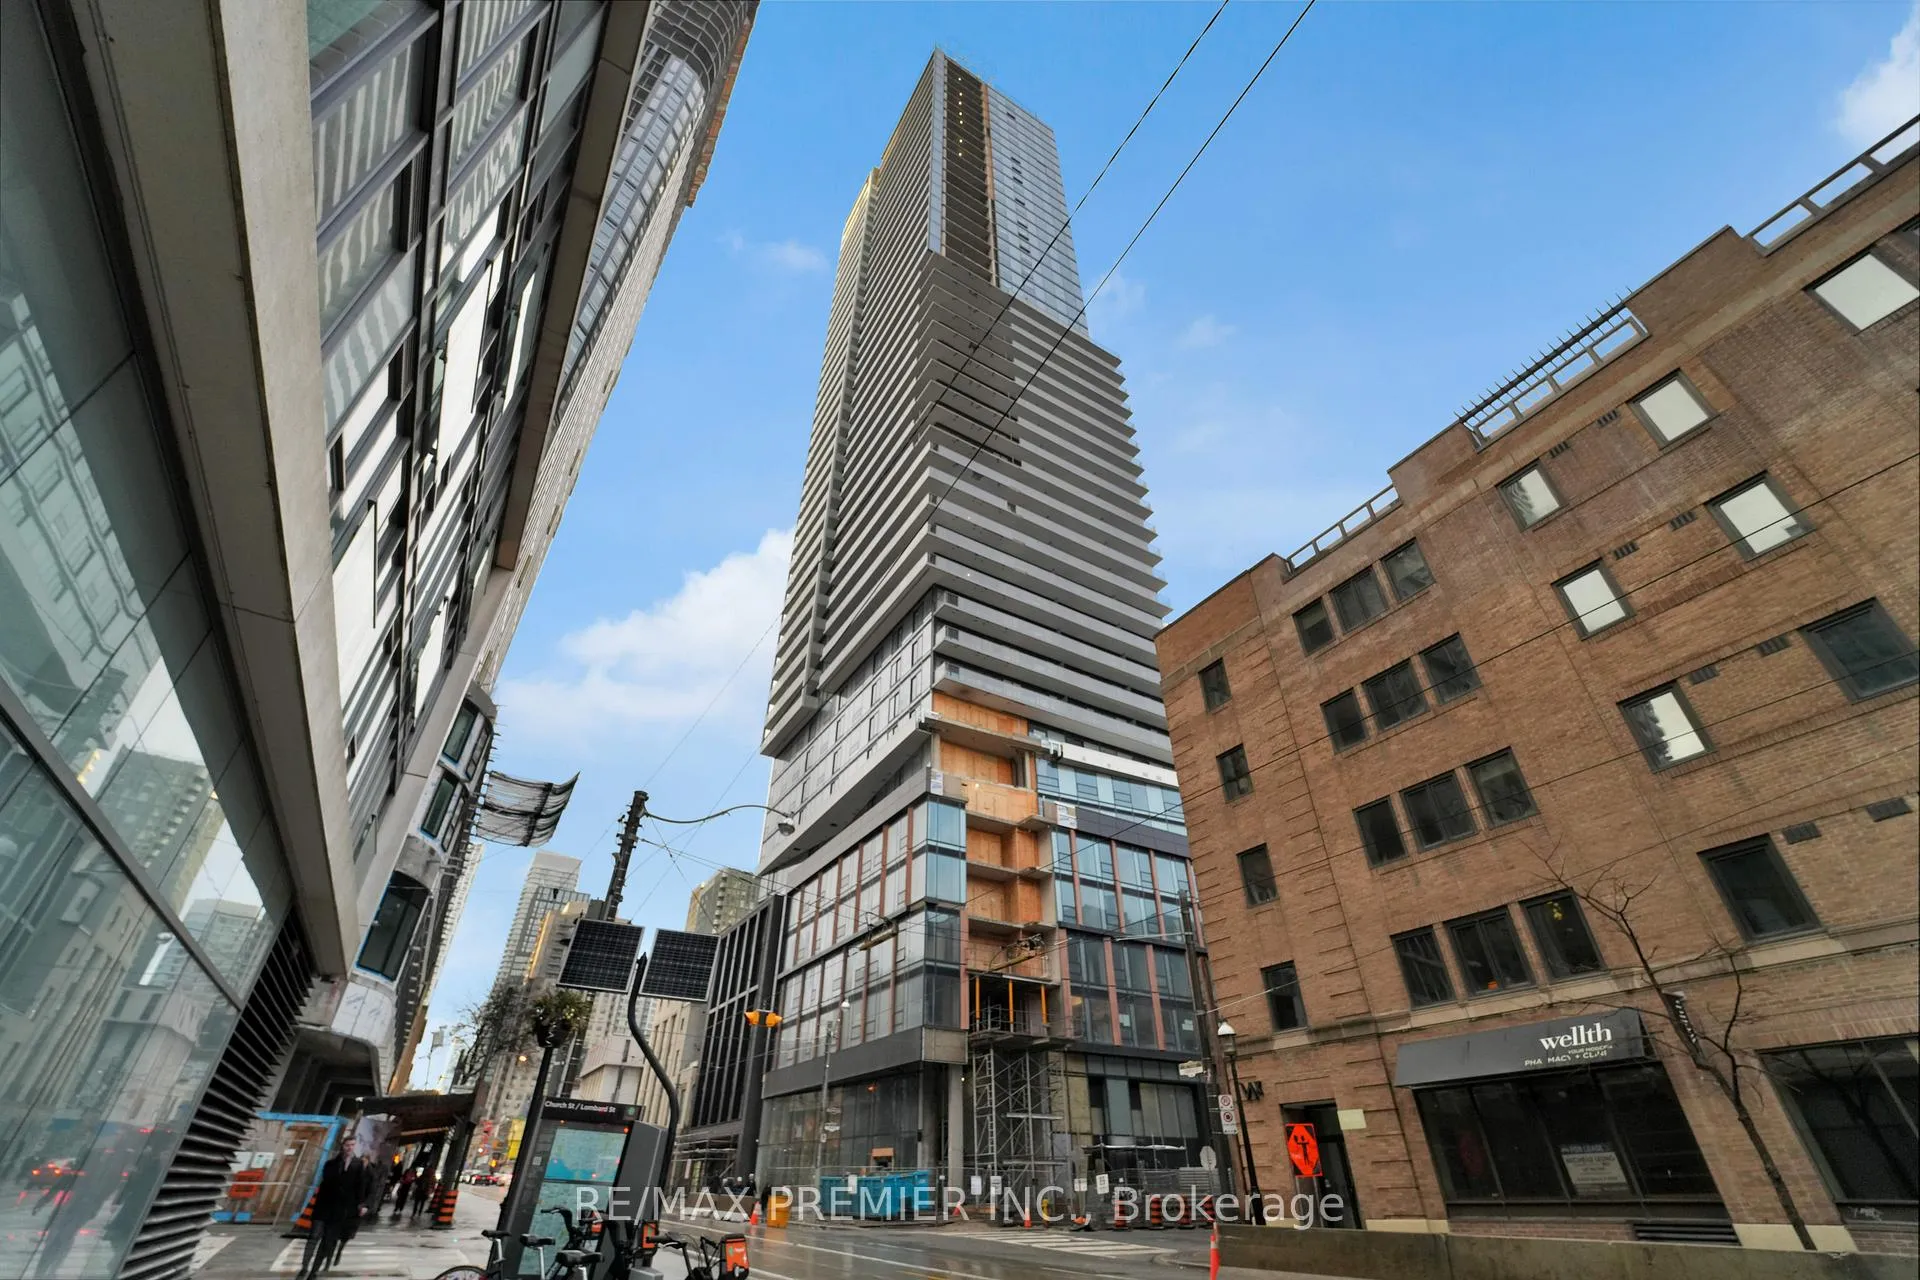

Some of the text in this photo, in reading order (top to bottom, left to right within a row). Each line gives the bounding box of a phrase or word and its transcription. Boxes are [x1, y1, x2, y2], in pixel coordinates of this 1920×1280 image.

[1539, 1022, 1612, 1050] wellth
[1524, 1055, 1571, 1066] PHAMAC
[544, 1101, 568, 1109] Church
[568, 1102, 575, 1110] St
[580, 1104, 608, 1113] Lombard
